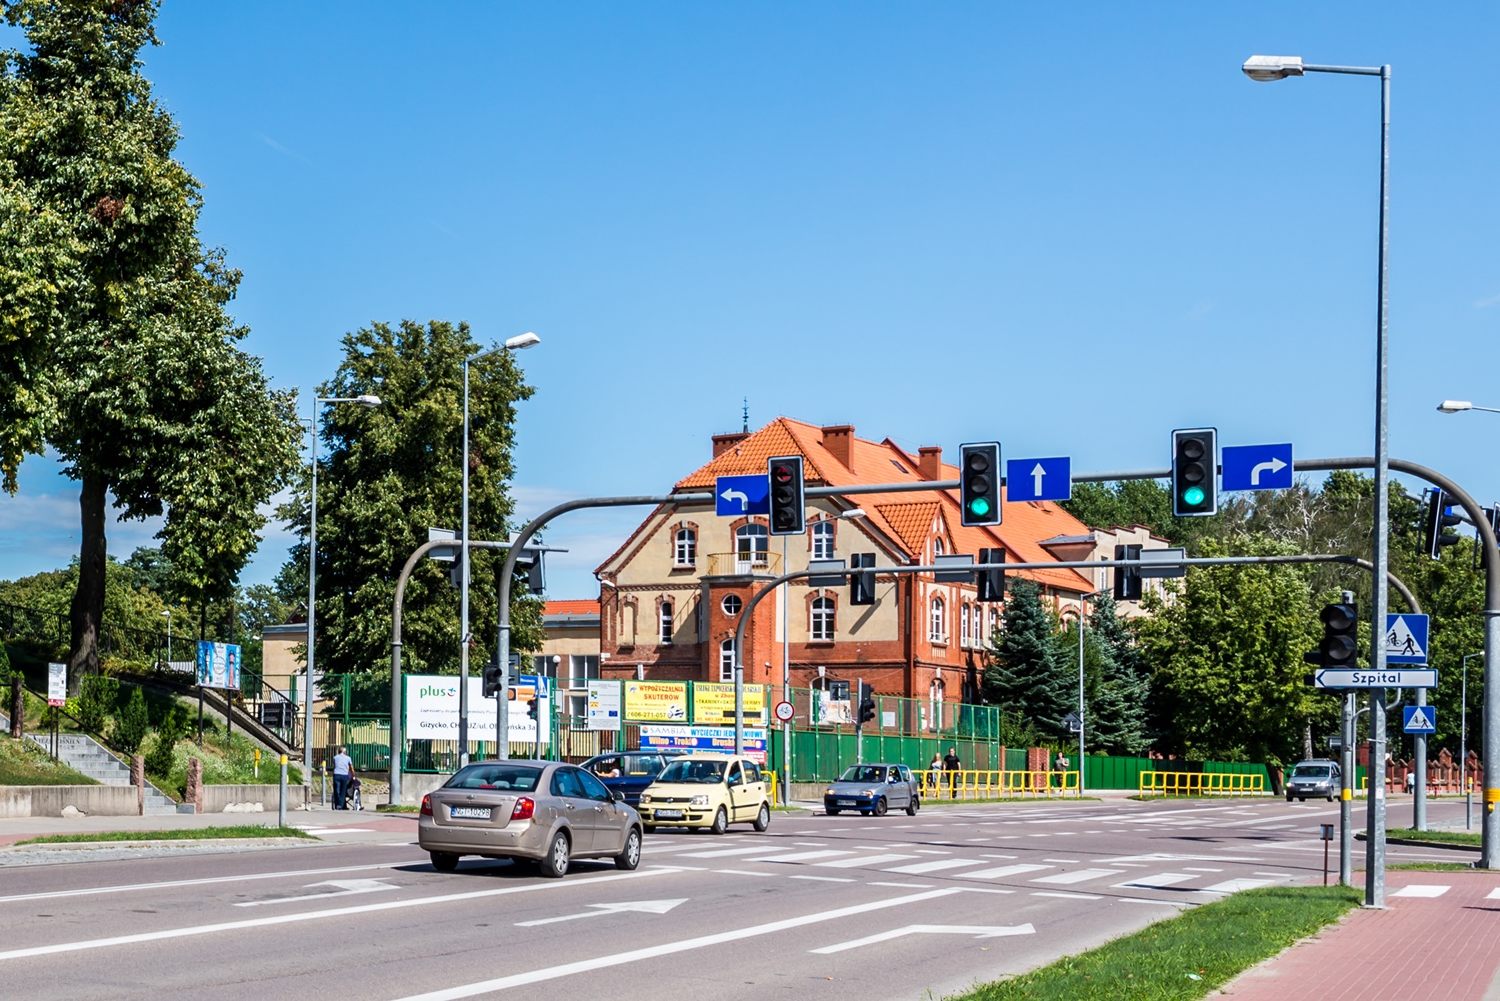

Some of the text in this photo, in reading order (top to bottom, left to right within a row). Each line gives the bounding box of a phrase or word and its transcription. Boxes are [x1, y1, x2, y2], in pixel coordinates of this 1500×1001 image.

[1352, 673, 1401, 686] Szpital
[420, 685, 446, 698] plus
[639, 684, 684, 693] WYPOŻYCZALNIA
[643, 693, 680, 701] SKUTERÓW
[420, 721, 449, 729] Giżycko,
[650, 727, 686, 735] SAMBIA
[691, 728, 722, 737] WYCIECZKI
